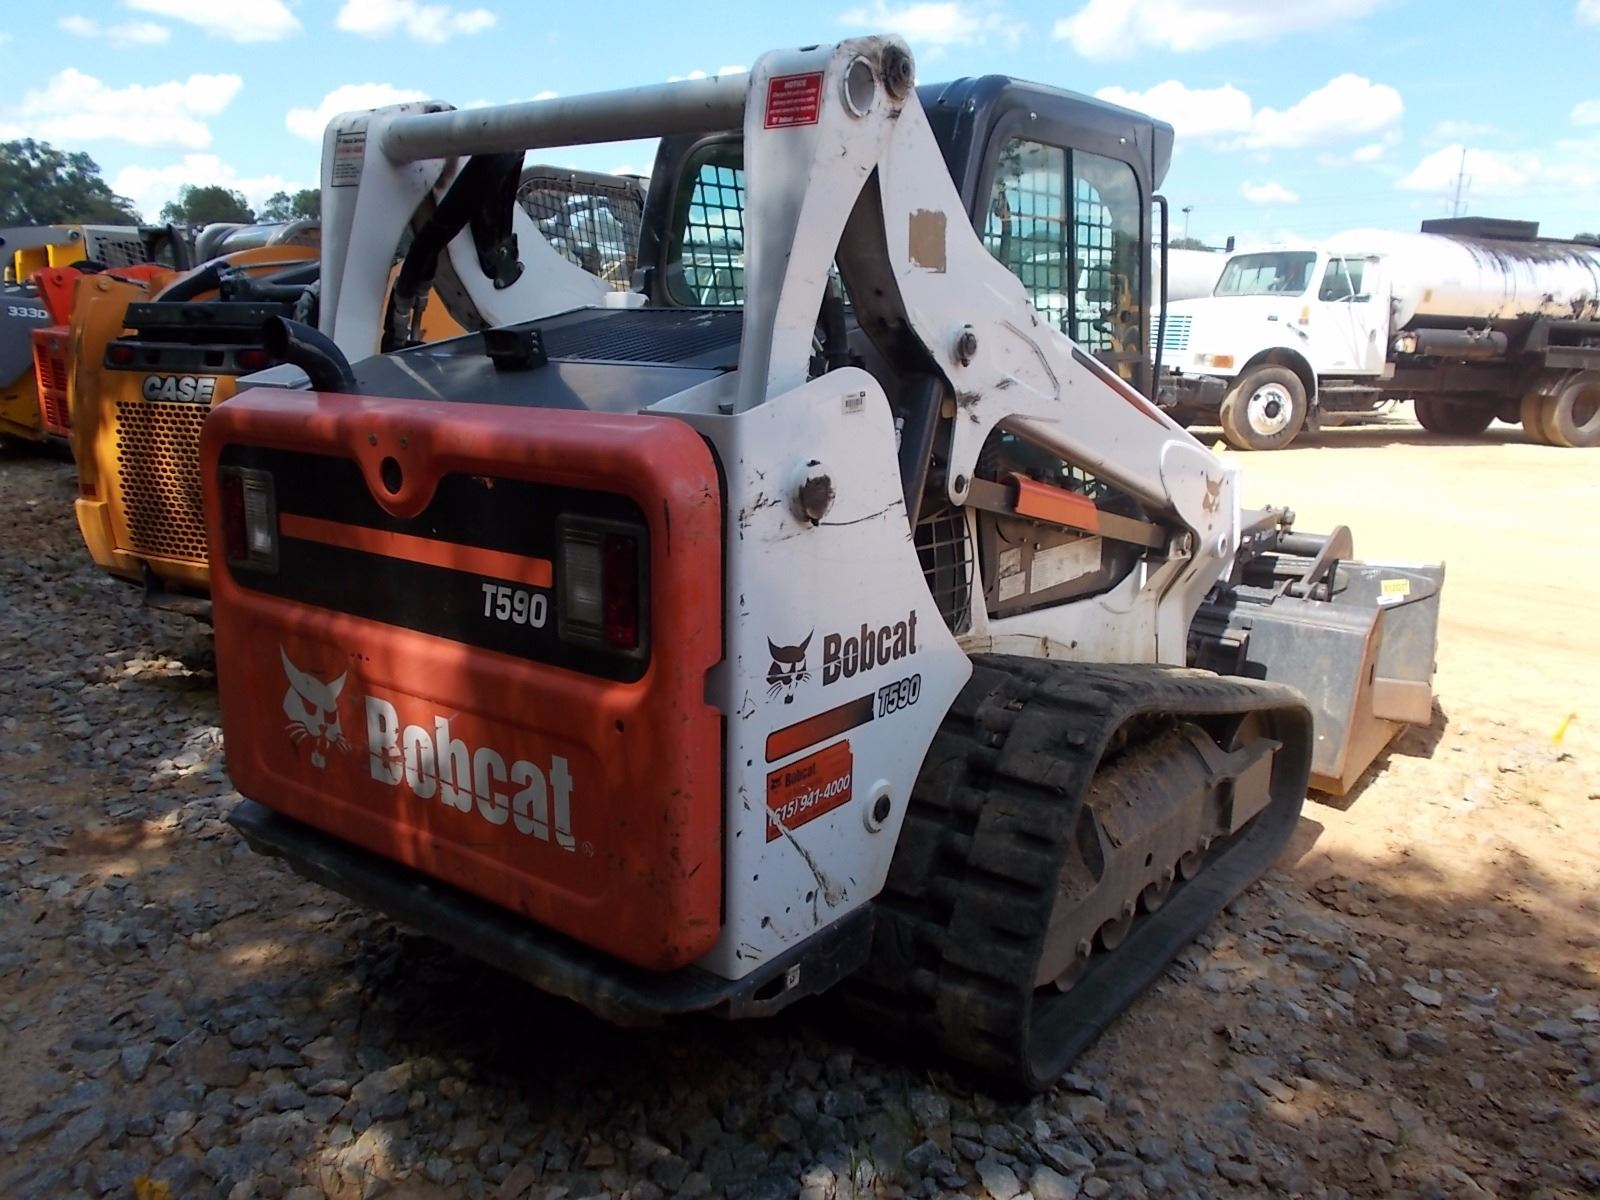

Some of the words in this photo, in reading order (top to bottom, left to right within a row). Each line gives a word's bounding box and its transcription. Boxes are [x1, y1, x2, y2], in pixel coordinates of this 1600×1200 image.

[8, 305, 48, 319] 333D
[143, 375, 216, 403] CASE
[482, 583, 548, 629] T590
[822, 609, 917, 687] Bobcat
[878, 673, 921, 718] T590
[365, 695, 576, 852] Bobcat
[800, 774, 850, 812] 941-4000
